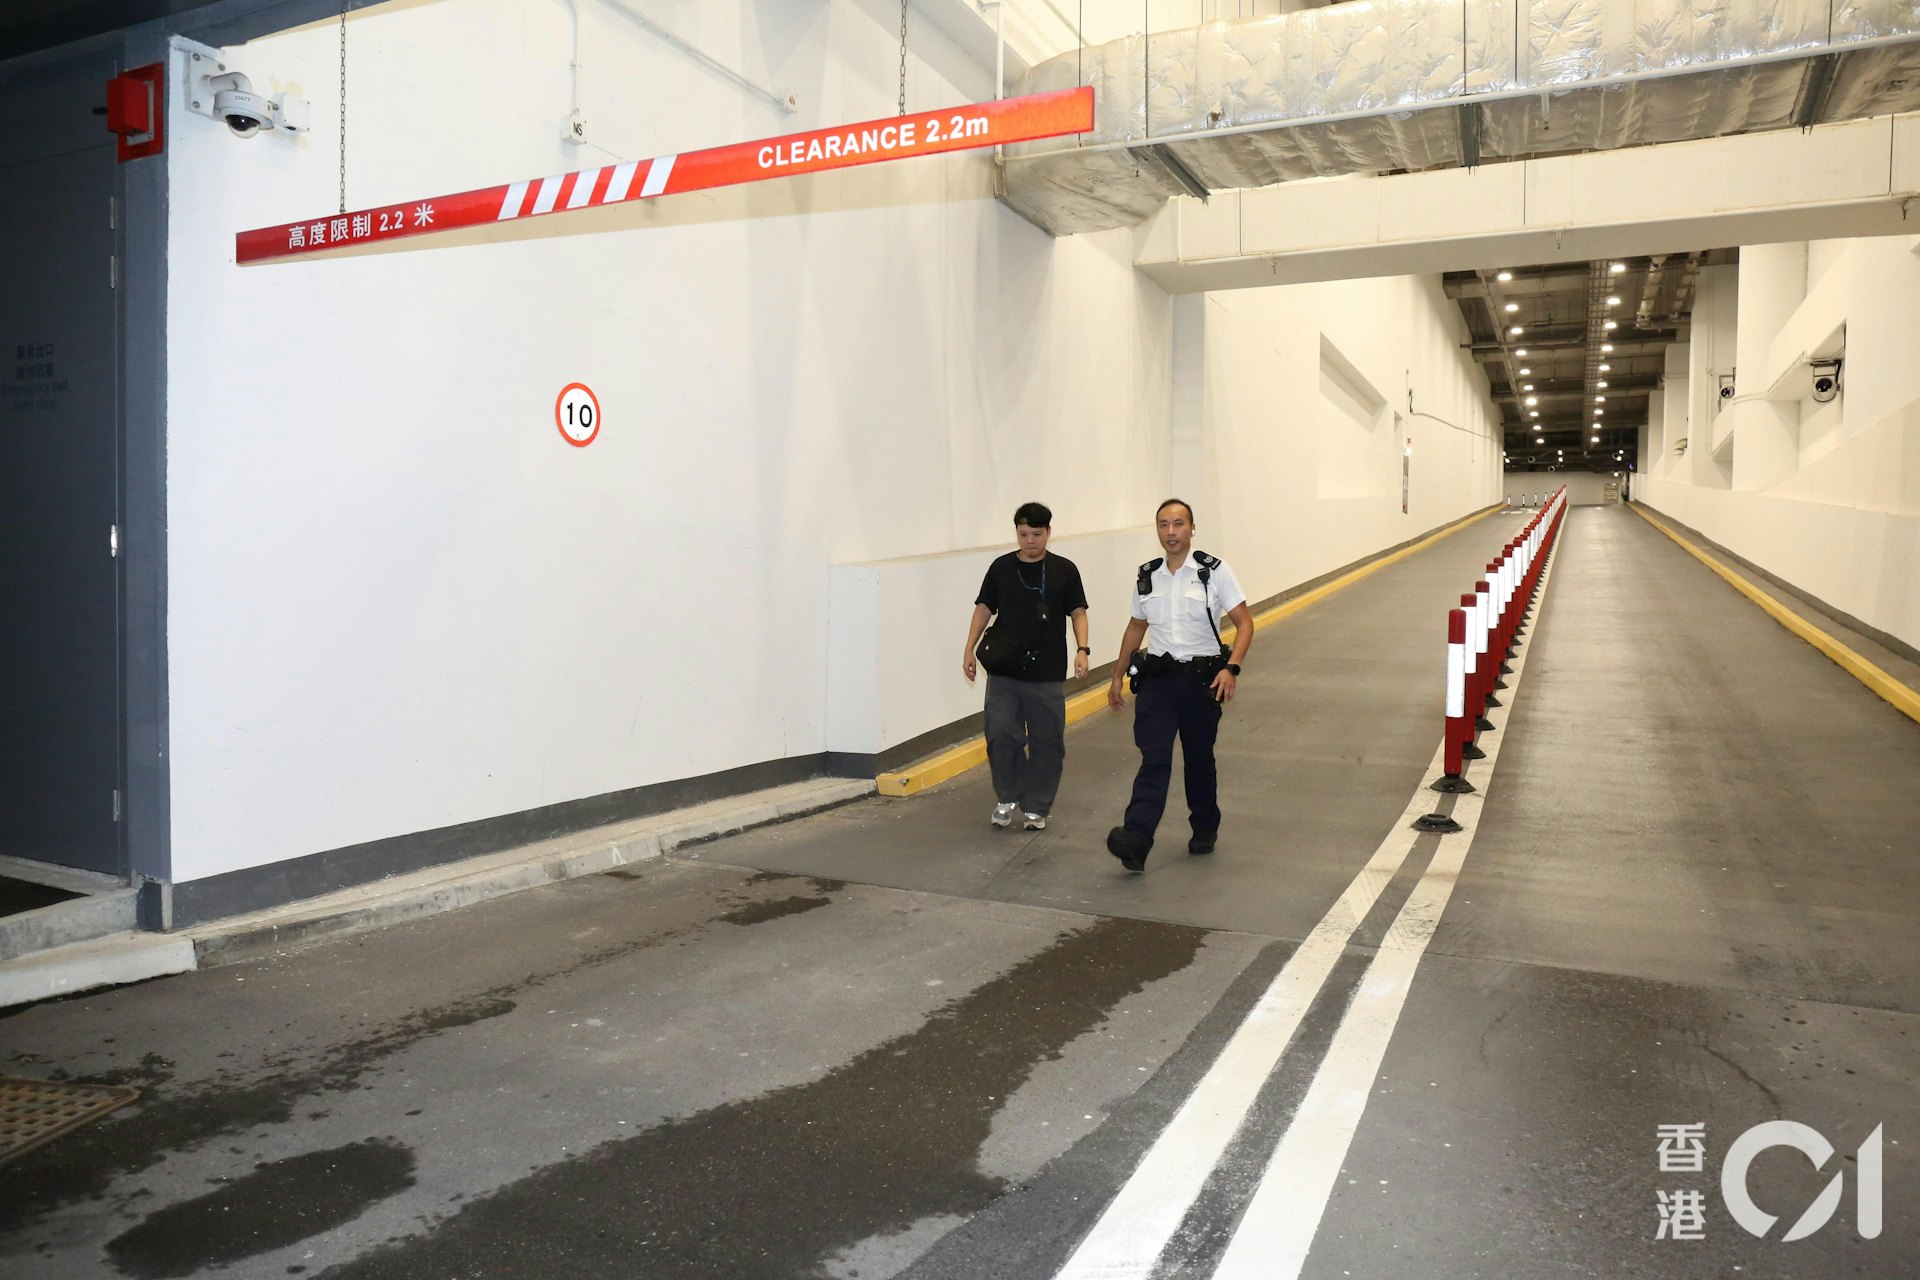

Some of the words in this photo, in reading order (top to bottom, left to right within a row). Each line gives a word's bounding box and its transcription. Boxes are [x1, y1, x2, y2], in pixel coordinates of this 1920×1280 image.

[573, 121, 583, 136] MS
[758, 124, 915, 168] CLEARANCE
[926, 116, 988, 142] 2.2m
[288, 213, 371, 249] 高度限制
[379, 211, 404, 232] 2.2
[414, 203, 435, 228] 米
[567, 402, 592, 428] 10
